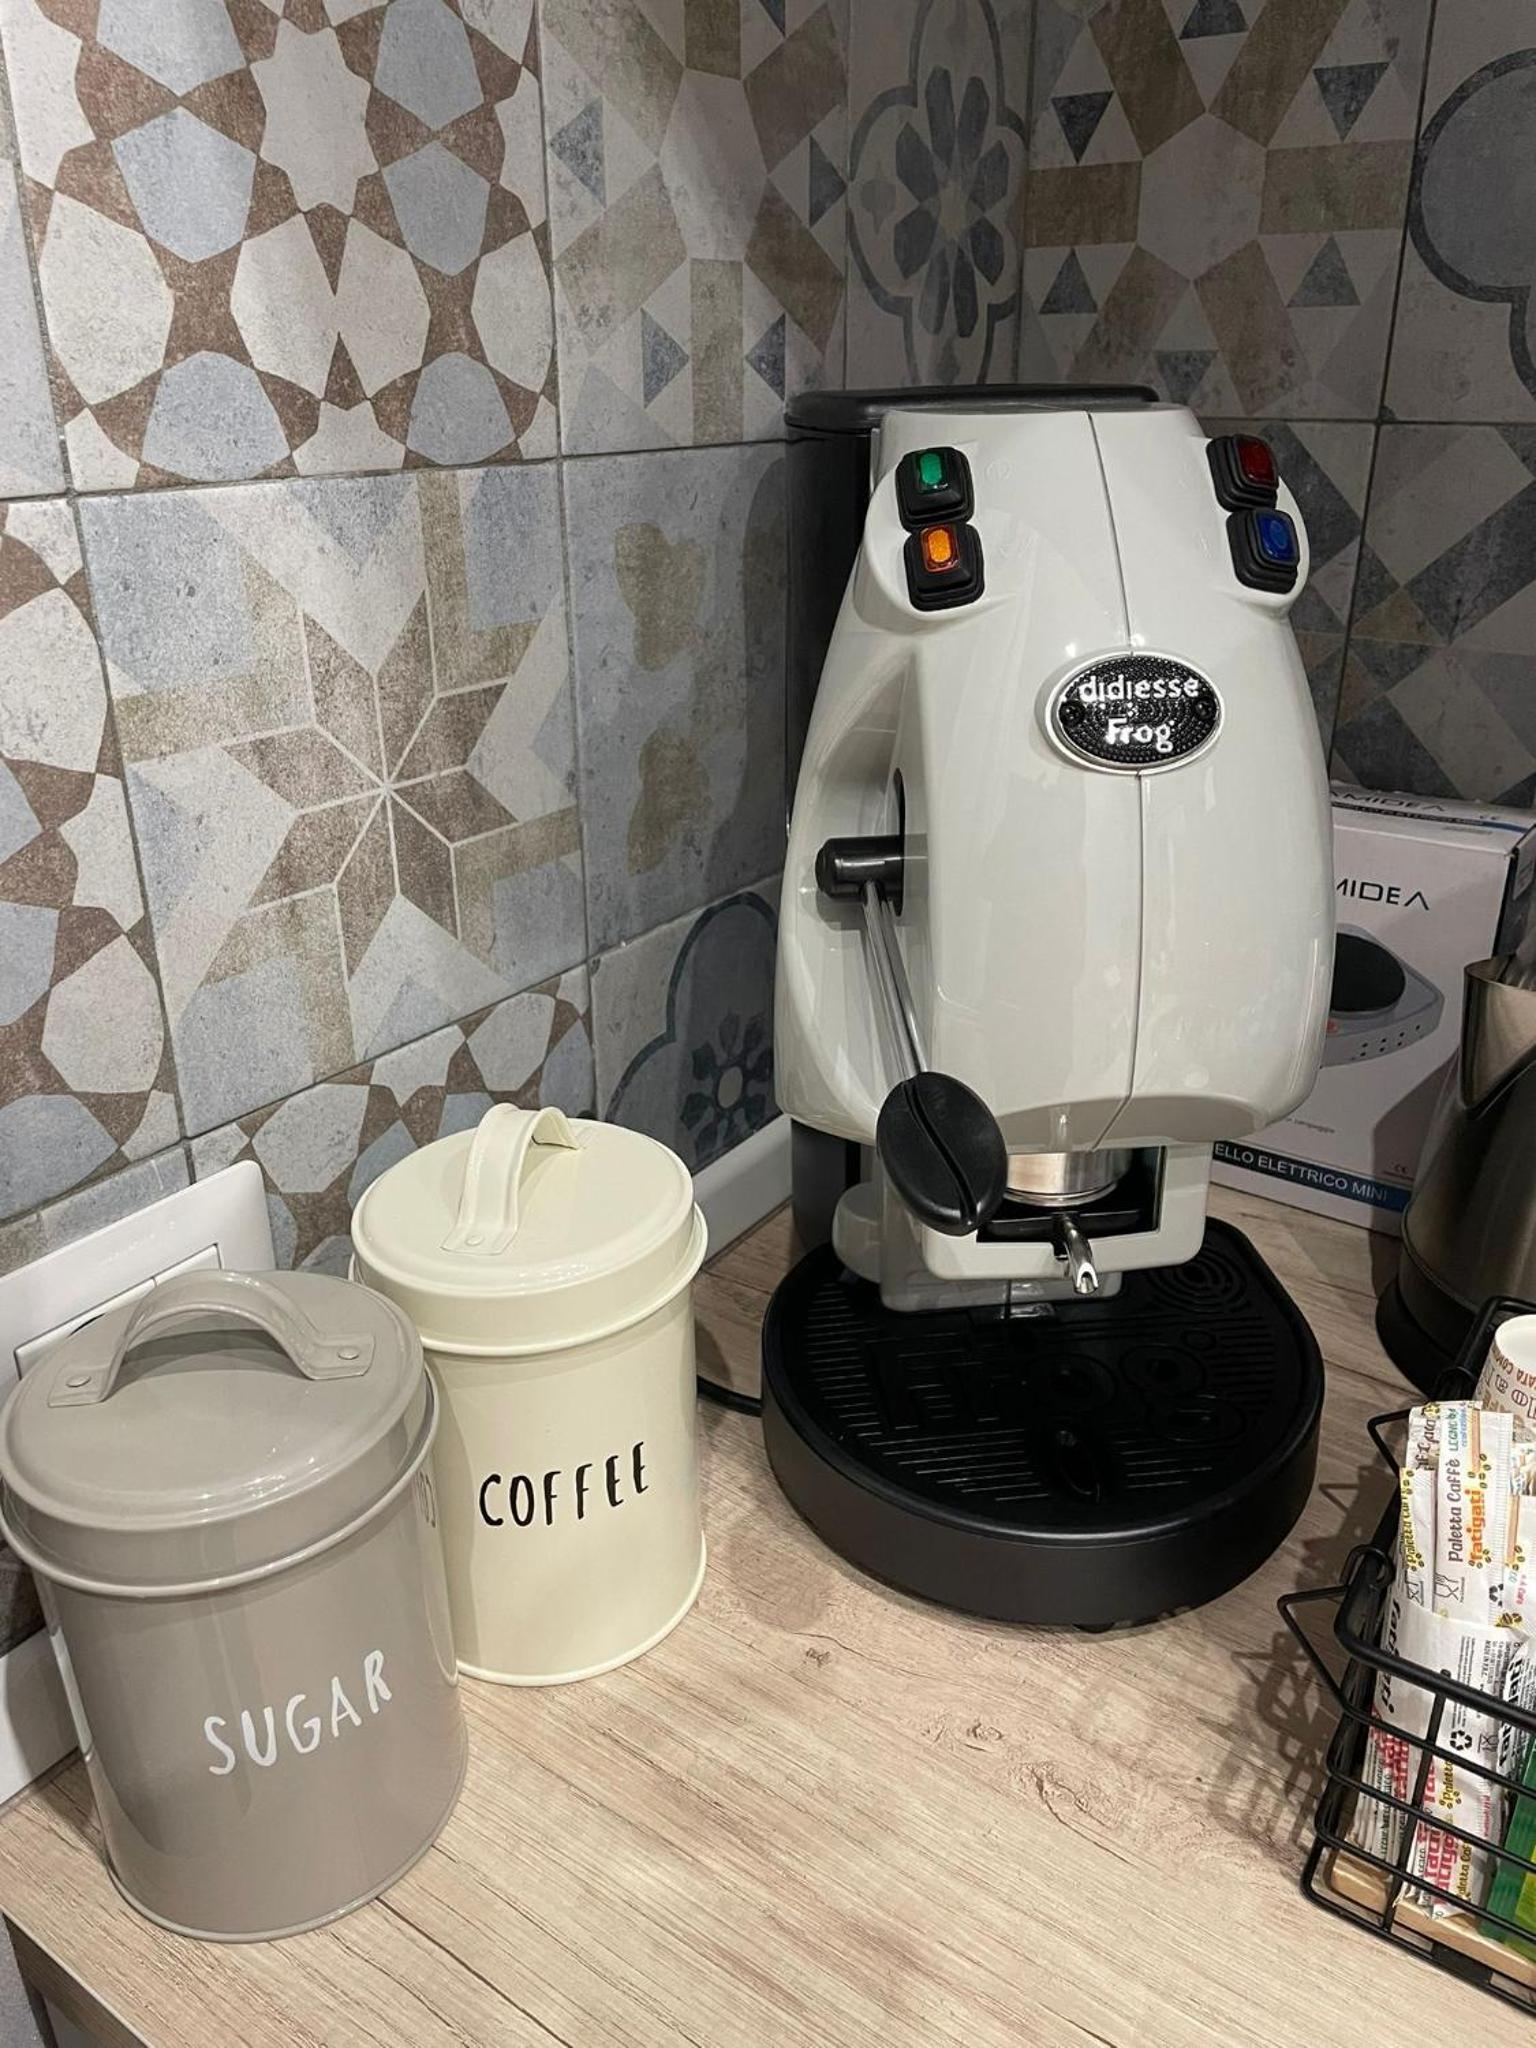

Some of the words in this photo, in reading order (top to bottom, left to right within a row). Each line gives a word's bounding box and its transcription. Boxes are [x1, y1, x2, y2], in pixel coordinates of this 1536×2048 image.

[1104, 716, 1174, 753] Frog
[1257, 1155, 1349, 1190] ELETTRICO
[1351, 1181, 1388, 1201] MINI
[478, 1441, 649, 1527] COFFEE
[1445, 1458, 1463, 1503] Caffè
[1447, 1507, 1464, 1563] Paletta
[1465, 1489, 1486, 1562] fatigati
[203, 1649, 393, 1776] SUGAR
